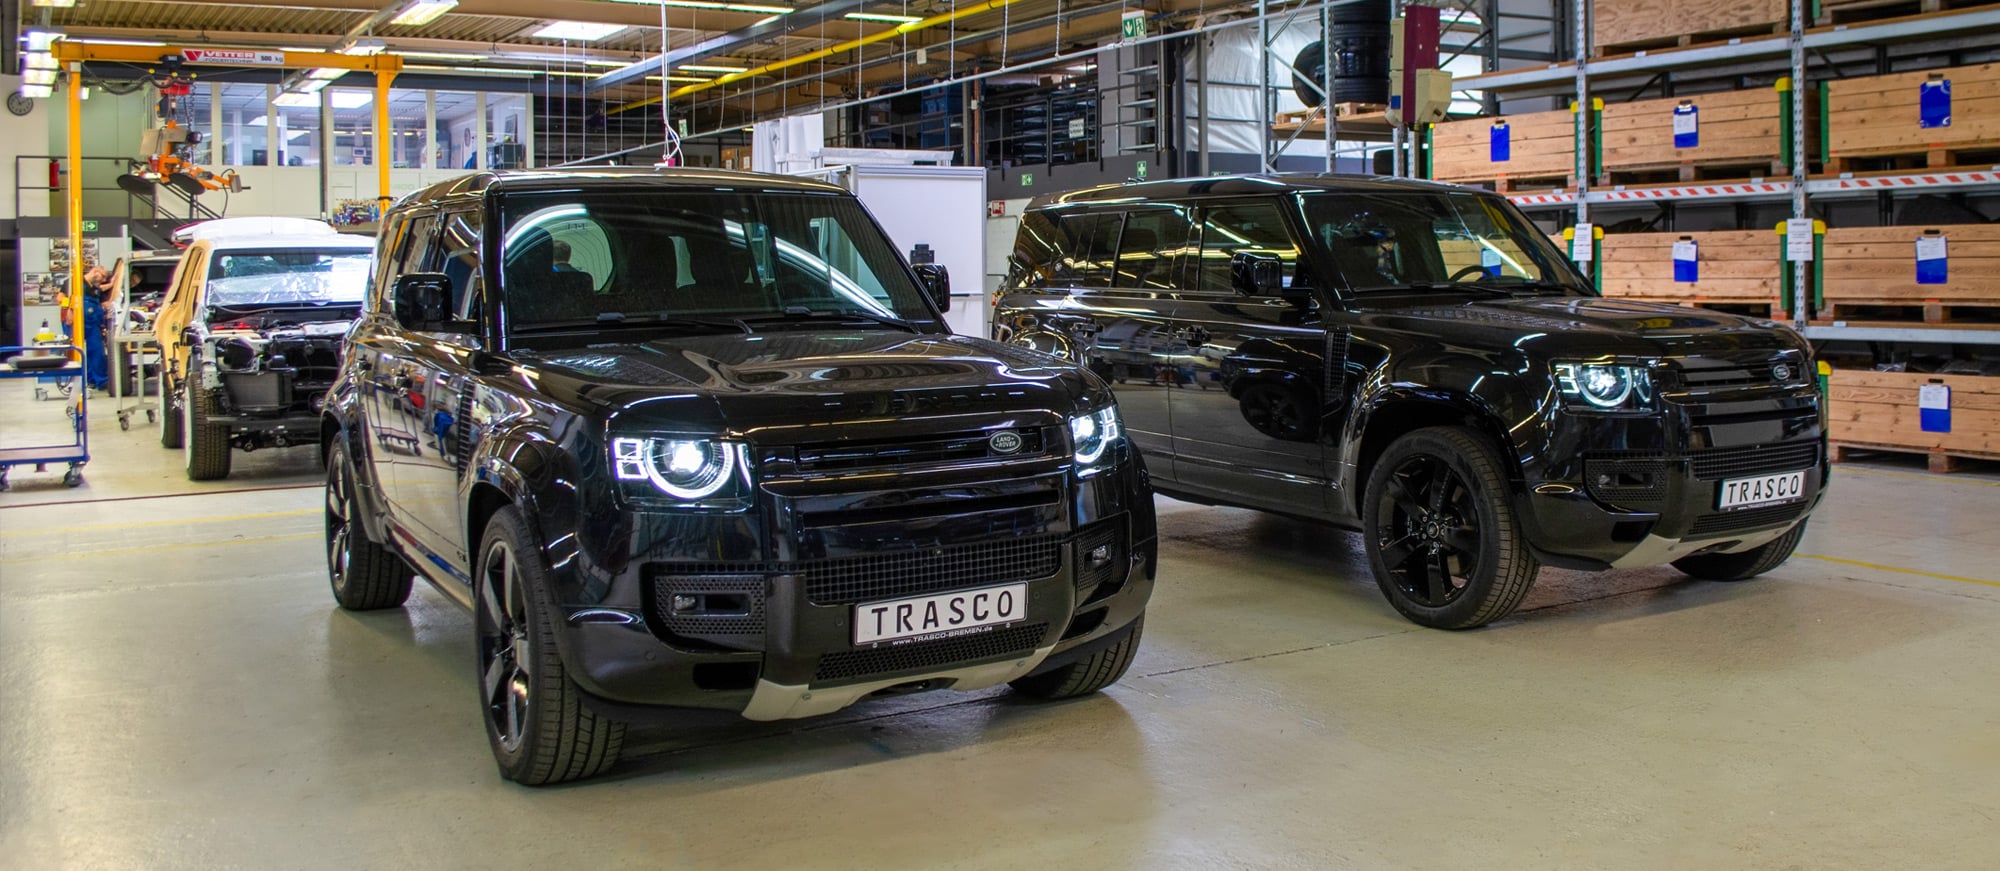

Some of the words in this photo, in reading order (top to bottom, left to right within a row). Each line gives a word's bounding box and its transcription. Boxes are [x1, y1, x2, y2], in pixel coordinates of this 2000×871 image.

[204, 50, 255, 59] VETTER
[275, 56, 284, 64] kg
[1728, 475, 1799, 504] TRASCO
[871, 590, 1013, 636] TRASCO
[892, 626, 993, 646] www.TRASCO-BREMEN.de
